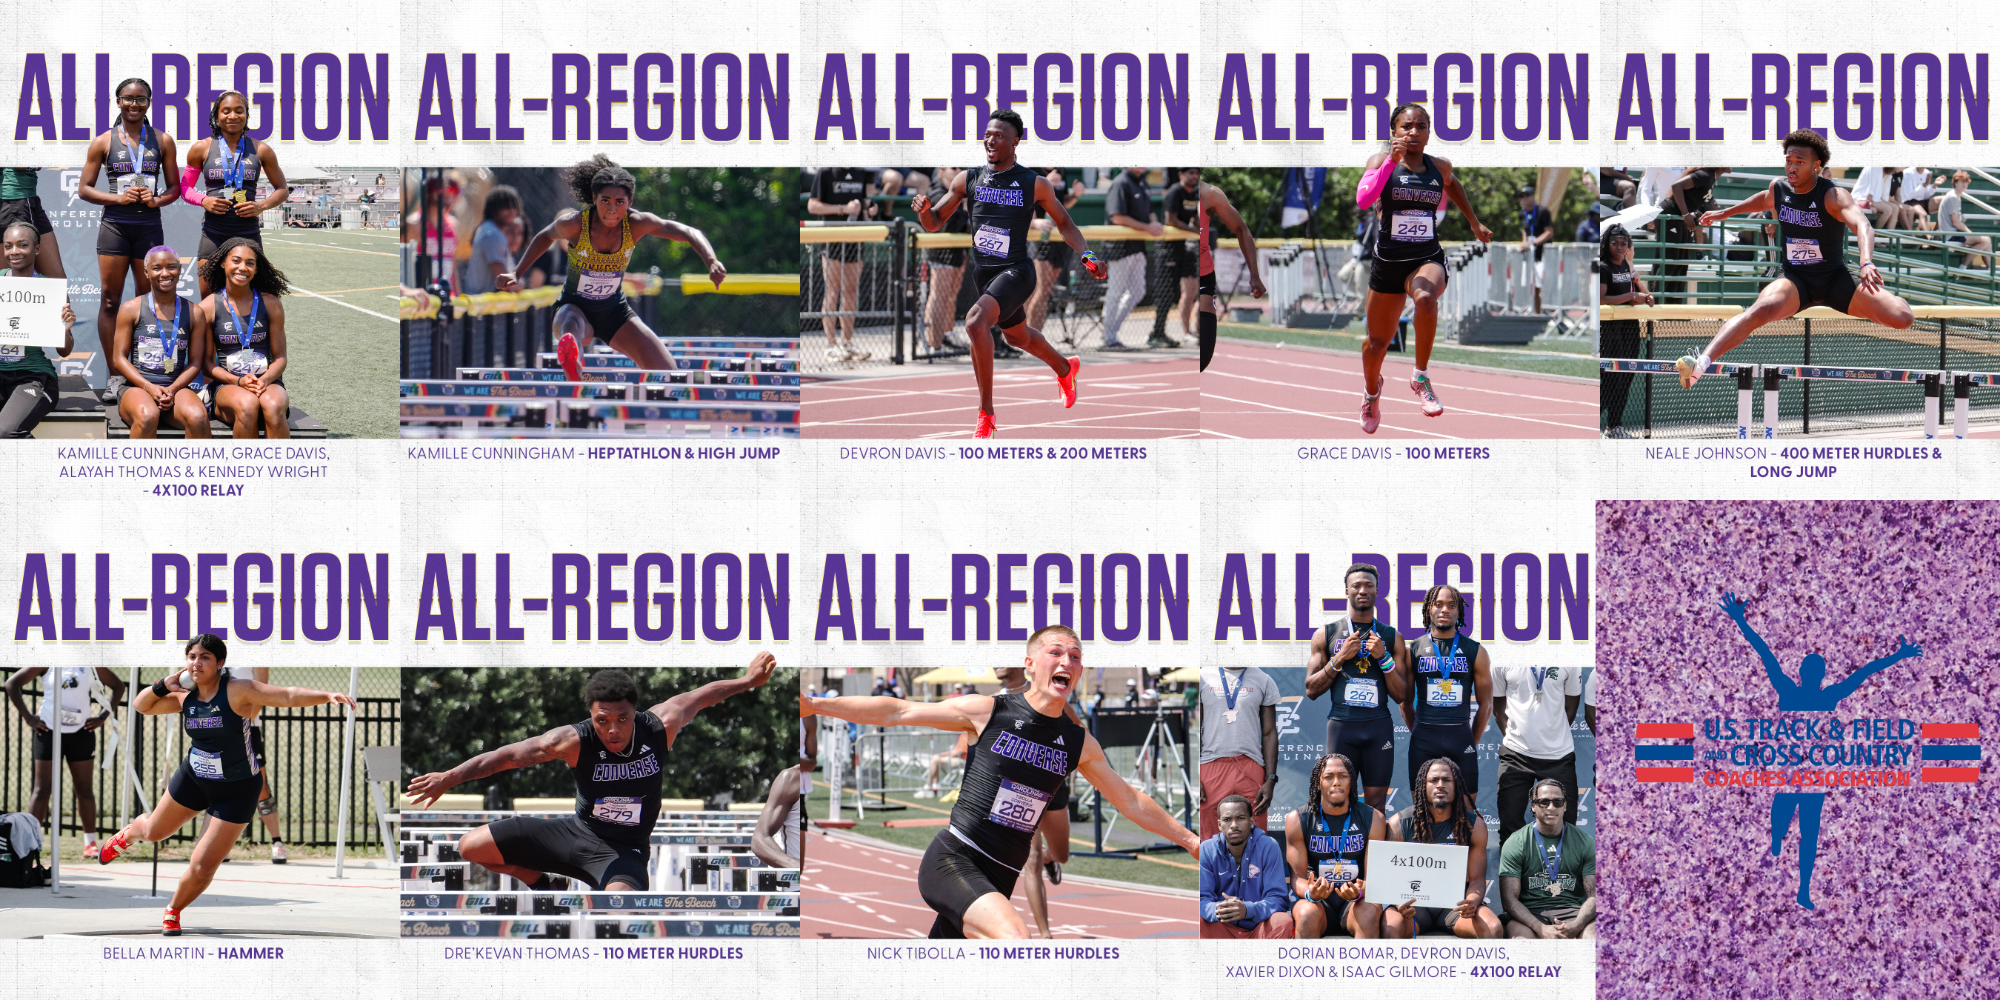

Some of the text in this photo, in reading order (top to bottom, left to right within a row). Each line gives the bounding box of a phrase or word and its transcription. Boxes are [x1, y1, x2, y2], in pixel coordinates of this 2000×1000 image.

[974, 185, 1024, 207] CONVERSE
[1779, 204, 1823, 228] CONVERSE
[1398, 224, 1428, 236] 249
[979, 237, 1004, 251] 267
[1792, 249, 1817, 260] 275
[584, 284, 614, 295] 247
[232, 362, 262, 374] 247
[463, 386, 475, 395] WE
[476, 387, 490, 395] ARE
[490, 386, 508, 396] The
[735, 390, 780, 401] WE ARE The
[1350, 690, 1375, 702] 267
[1431, 691, 1457, 702] 265
[186, 716, 223, 729] CONVERSE
[991, 730, 1068, 776] CONVERSE
[193, 761, 217, 774] 255
[592, 753, 660, 782] CONVERSE
[832, 724, 842, 805] FINISH
[599, 807, 633, 822] 279
[998, 800, 1036, 823] 280
[1390, 854, 1447, 870] 4x100m
[418, 868, 441, 876] GILL
[465, 897, 491, 906] GILL
[558, 897, 585, 906] GILL
[634, 896, 717, 909] WE ARE The Beach
[766, 898, 793, 907] GILL
[413, 921, 451, 936] Beach
[510, 924, 540, 933] GILL
[626, 924, 656, 933] GILL
[715, 924, 731, 935] WE
[731, 924, 750, 935] ARE
[751, 923, 774, 937] The
